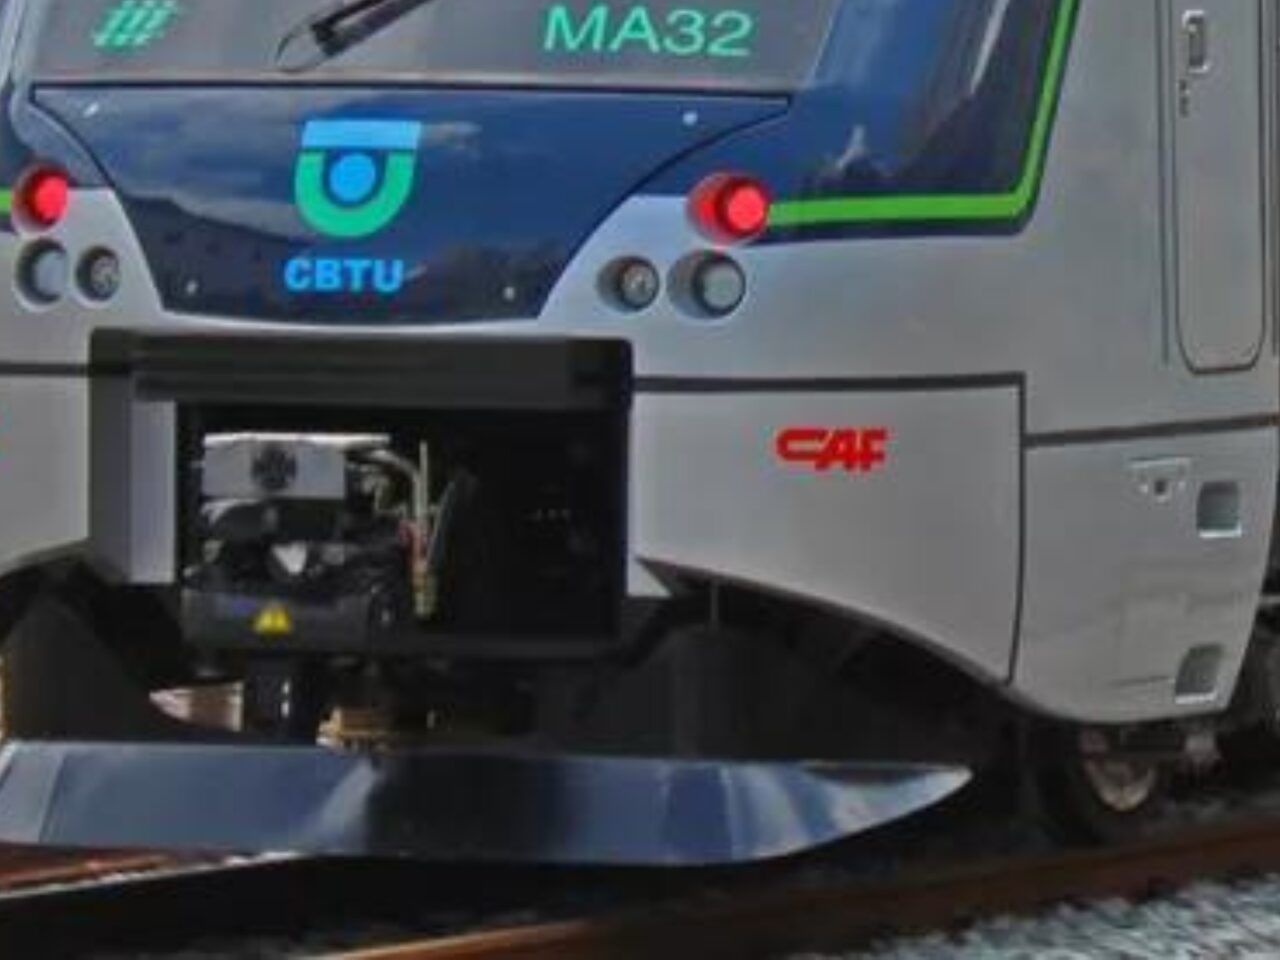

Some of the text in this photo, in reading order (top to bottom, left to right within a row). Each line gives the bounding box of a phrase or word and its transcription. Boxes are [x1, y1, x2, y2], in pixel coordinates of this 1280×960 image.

[543, 5, 752, 58] MA32
[283, 257, 404, 294] CBTU
[775, 427, 888, 472] CAF
